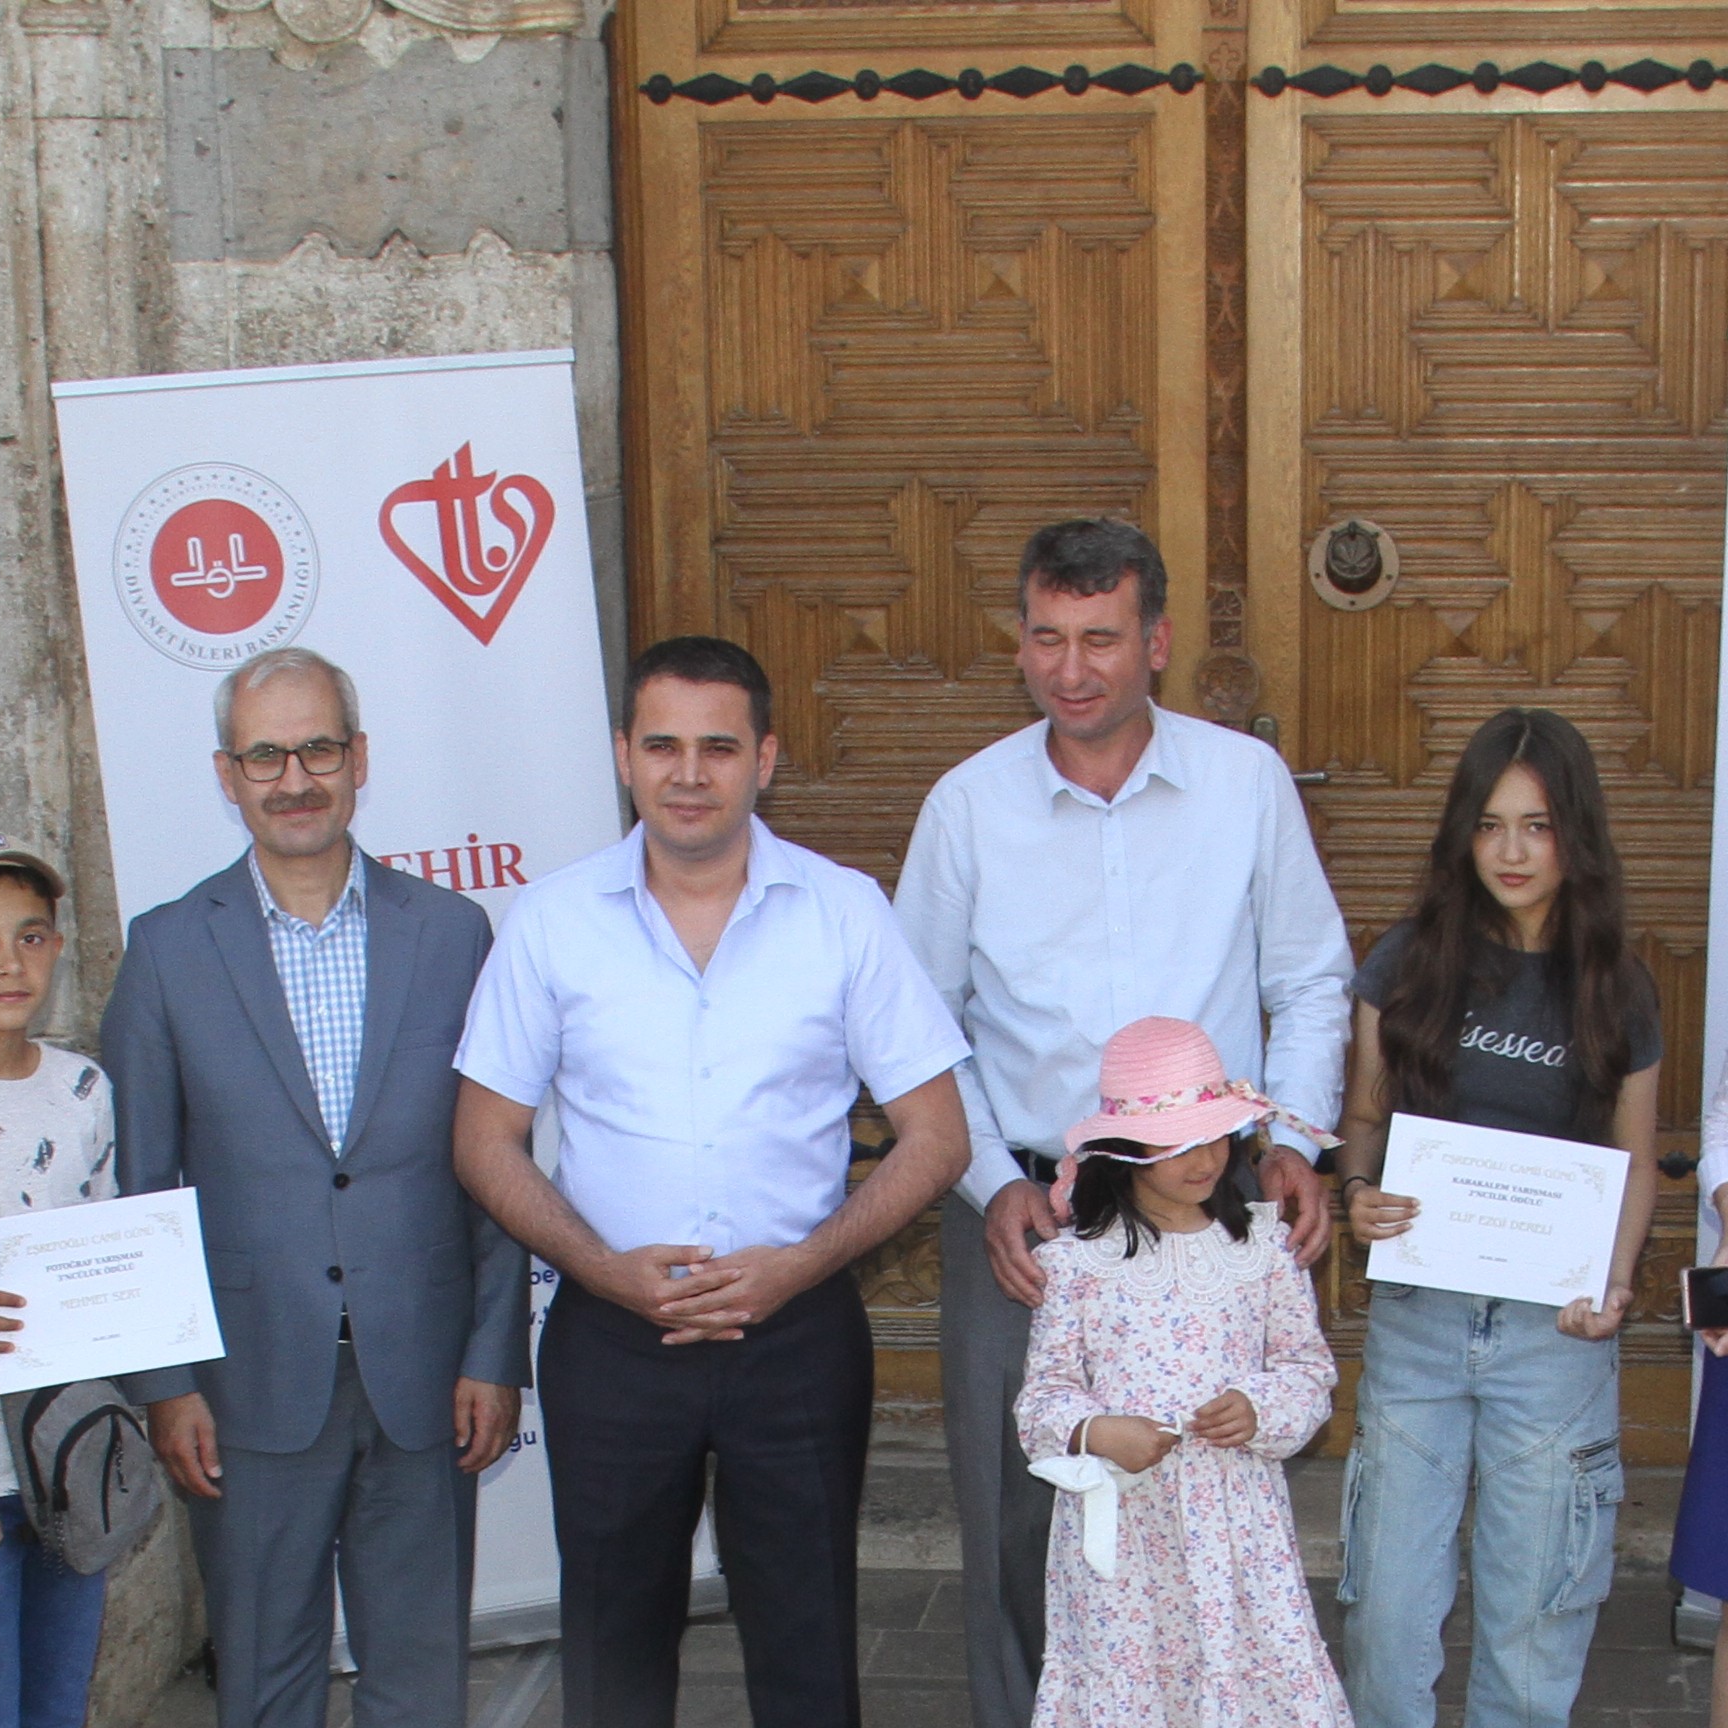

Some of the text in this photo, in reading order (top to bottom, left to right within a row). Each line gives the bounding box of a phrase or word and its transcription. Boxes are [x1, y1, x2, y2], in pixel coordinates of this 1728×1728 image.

[125, 560, 310, 661] DİYANET İŞLERİ BAŞKANLIĞI
[1452, 1176, 1510, 1191] KARAKALEM
[46, 1258, 93, 1272] FOTOĞRAF
